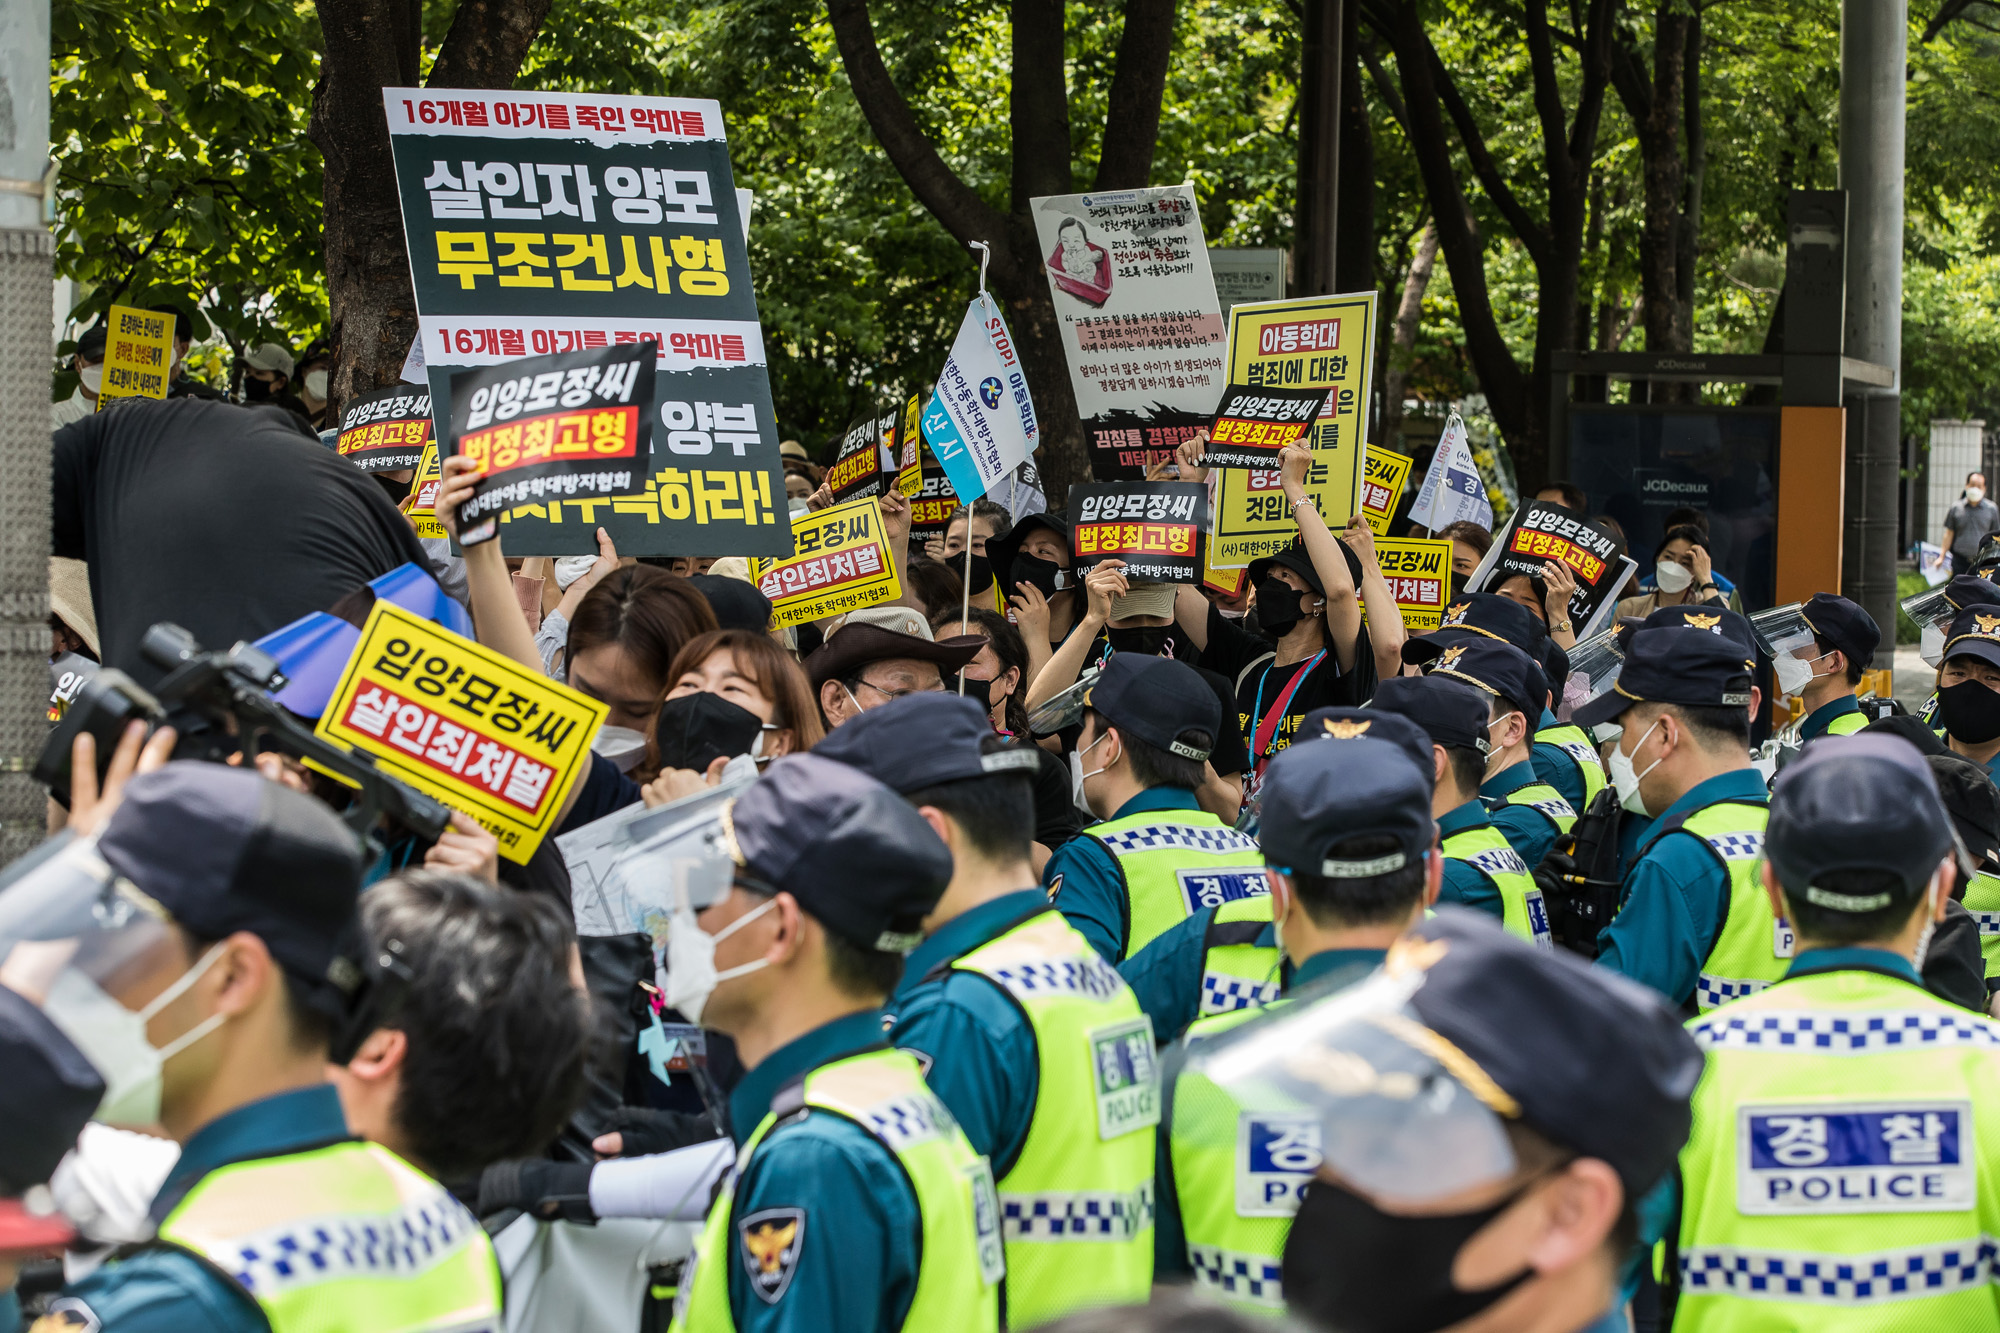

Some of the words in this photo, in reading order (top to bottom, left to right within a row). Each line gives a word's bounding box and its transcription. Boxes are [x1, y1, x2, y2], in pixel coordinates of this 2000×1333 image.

[402, 100, 489, 127] 16개월
[494, 101, 571, 130] 아기를
[576, 104, 625, 132] 죽인
[630, 107, 705, 137] 악마들
[423, 160, 598, 223] 살인자
[604, 165, 718, 225] 양모
[435, 230, 730, 296] 무조건사형
[1088, 330, 1096, 339] 그
[1125, 326, 1150, 338] 아이가
[1151, 323, 1196, 337] 죽었습니다.
[1094, 316, 1110, 327] 모두
[1141, 312, 1158, 324] 하지
[438, 329, 527, 356] 16개월
[670, 333, 746, 362] 악마들
[985, 317, 1016, 367] STOP!
[1100, 341, 1108, 353] 이
[1110, 340, 1135, 352] 아이는
[1137, 339, 1146, 351] 이
[1262, 322, 1338, 352] 아동학대
[1079, 364, 1108, 378] 얼마나
[1110, 363, 1120, 376] 더
[1121, 362, 1141, 376] 많은
[1143, 360, 1171, 374] 아이가
[1174, 357, 1222, 373] 희생되어야
[1248, 359, 1303, 386] 범죄에
[1309, 355, 1348, 382] 대한
[1655, 360, 1706, 370] JCDecaux
[466, 361, 641, 430] 입양모장씨
[1098, 377, 1136, 392] 경찰답게
[1138, 374, 1211, 390] 일하시겠습니까!!
[343, 395, 432, 431] 입양모장씨
[1009, 372, 1036, 439] 아동학대
[1224, 395, 1319, 421] 입양모장씨
[338, 421, 425, 455] 법정최고형
[465, 411, 627, 474] 법정최고형
[660, 401, 761, 456] 양부
[941, 382, 954, 403] Abuse
[952, 403, 975, 441] Prevention
[972, 441, 991, 481] Association
[1093, 428, 1143, 449] 김창룡
[1213, 420, 1302, 446] 법정최고형
[1643, 480, 1708, 493] JCDecaux
[1080, 494, 1197, 521] 입양모장씨
[1079, 525, 1190, 553] 법정최고형
[1523, 509, 1616, 559] 입양모장씨
[760, 545, 881, 599] 살인죄처벌
[1516, 530, 1601, 580] 법정최고형
[373, 639, 577, 753] 입양모장씨
[349, 686, 551, 808] 살인죄처벌
[1766, 1112, 1946, 1167] 경찰
[1768, 1173, 1944, 1200] POLICE
